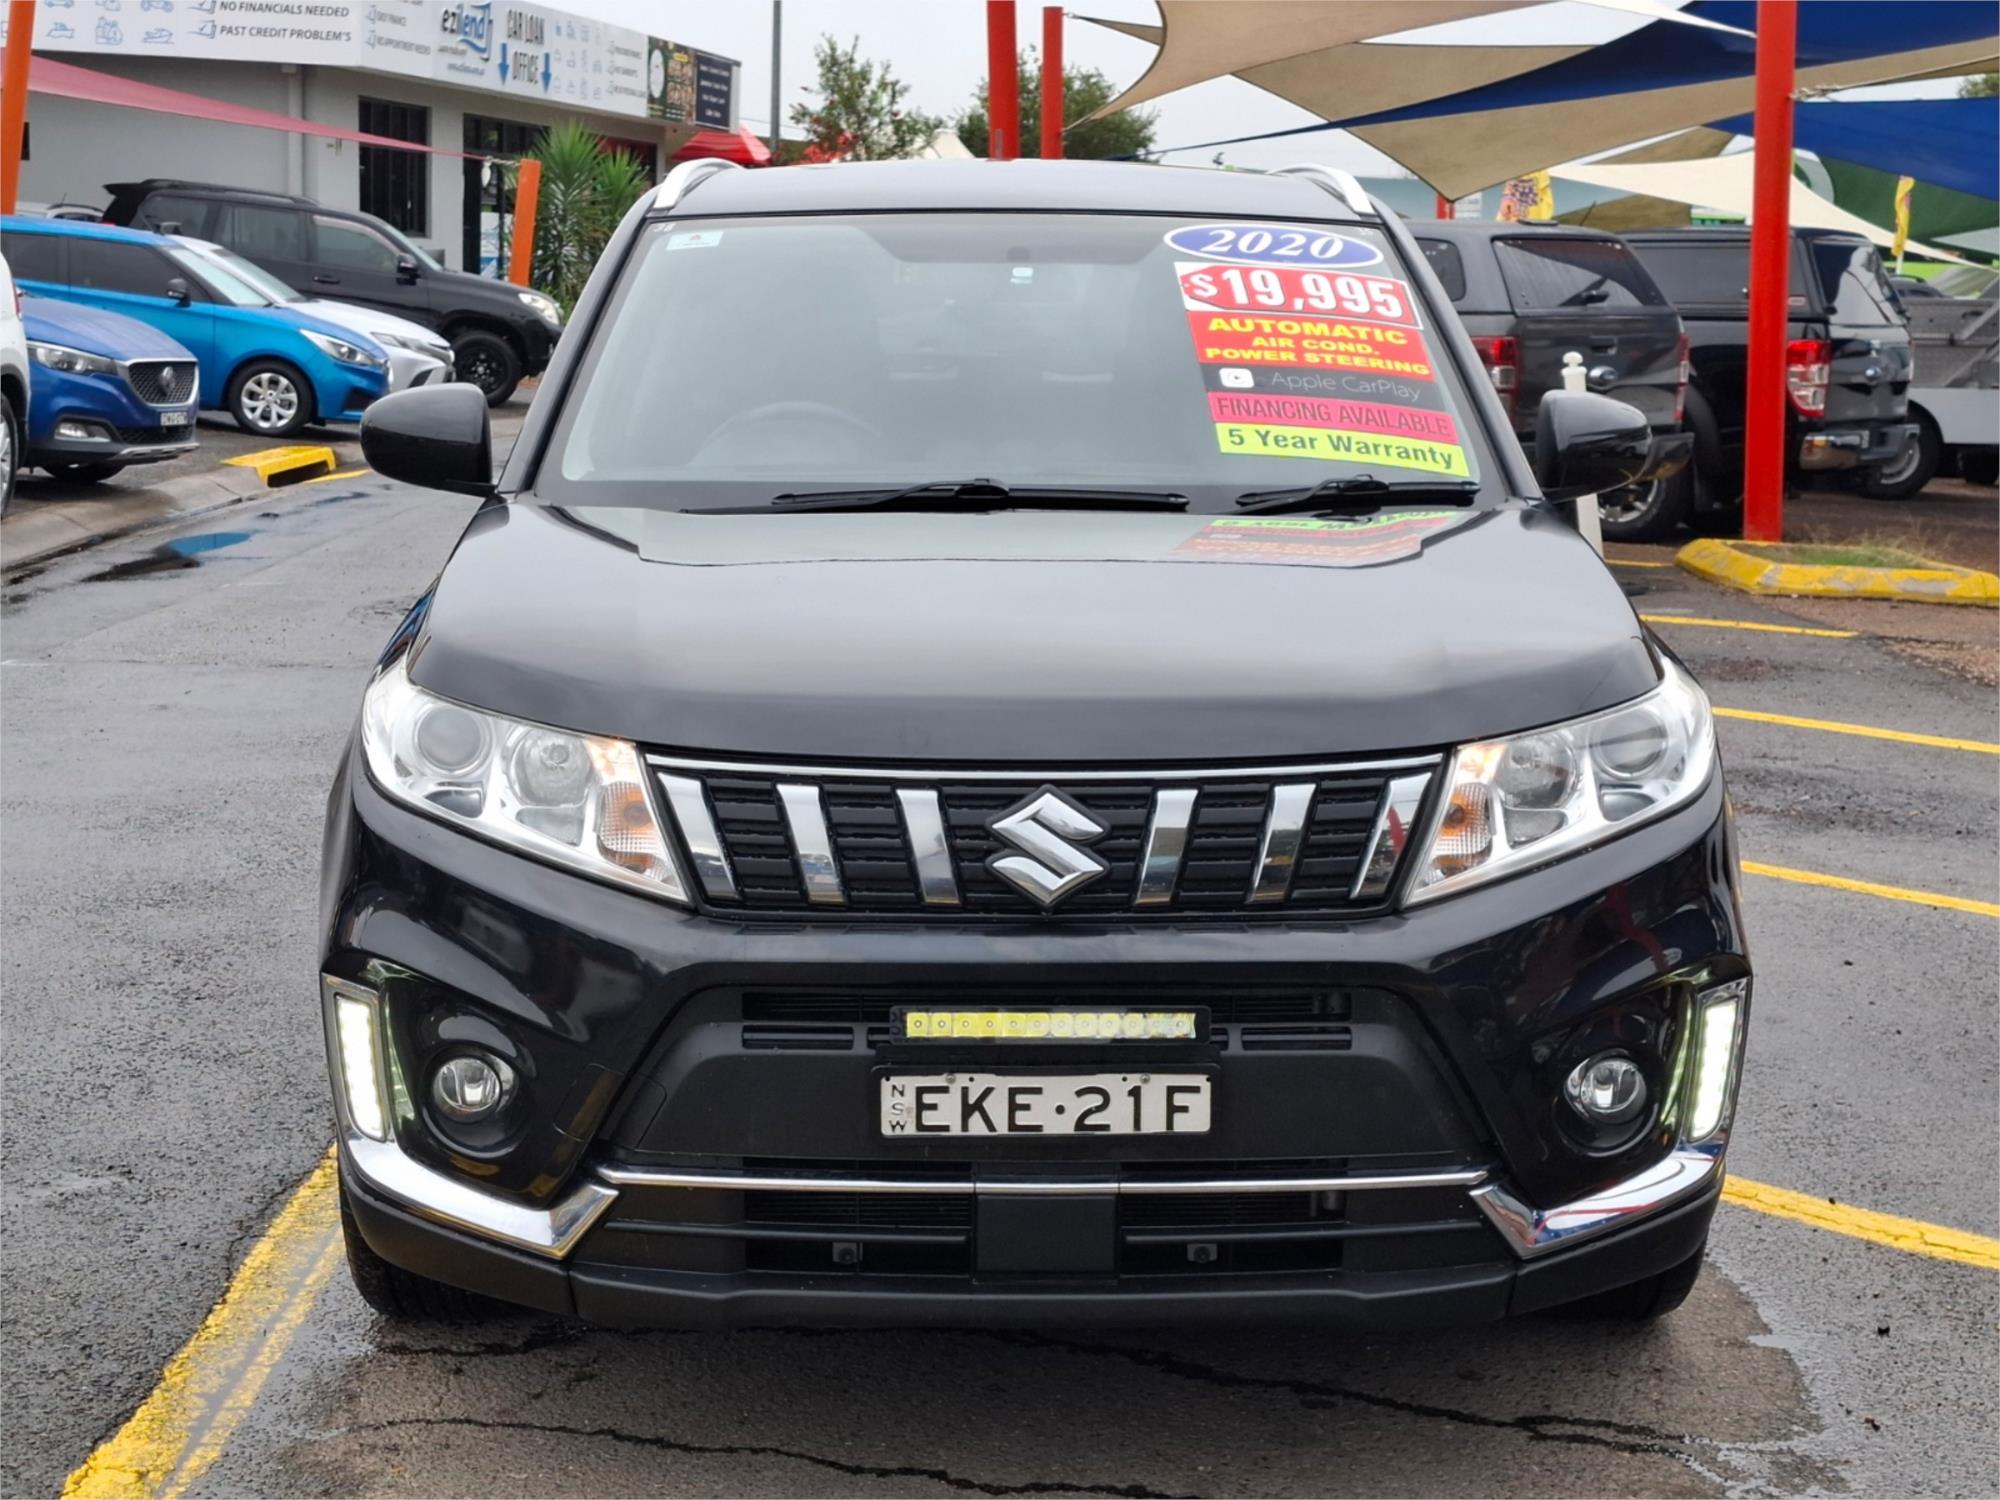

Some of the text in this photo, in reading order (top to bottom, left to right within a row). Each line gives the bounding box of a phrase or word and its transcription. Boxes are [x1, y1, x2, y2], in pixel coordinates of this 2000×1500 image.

[219, 1, 350, 18] NO FINANCIALS NEEDED
[219, 25, 352, 42] PAST CREDIT PROBLEM'S
[507, 9, 546, 46] CAR LOAN
[512, 49, 540, 85] OFFICE
[1200, 229, 1344, 259] 2020
[1189, 268, 1403, 318] $19,995
[1208, 317, 1409, 345] AUTOMATIC
[1252, 336, 1380, 355] AIR COND.
[1205, 348, 1430, 375] POWER STEERING
[1271, 372, 1421, 402] Apple CarPlay
[1216, 397, 1449, 436] FINANCING AVAILABLE
[1228, 428, 1453, 470] 5 Year Warranty
